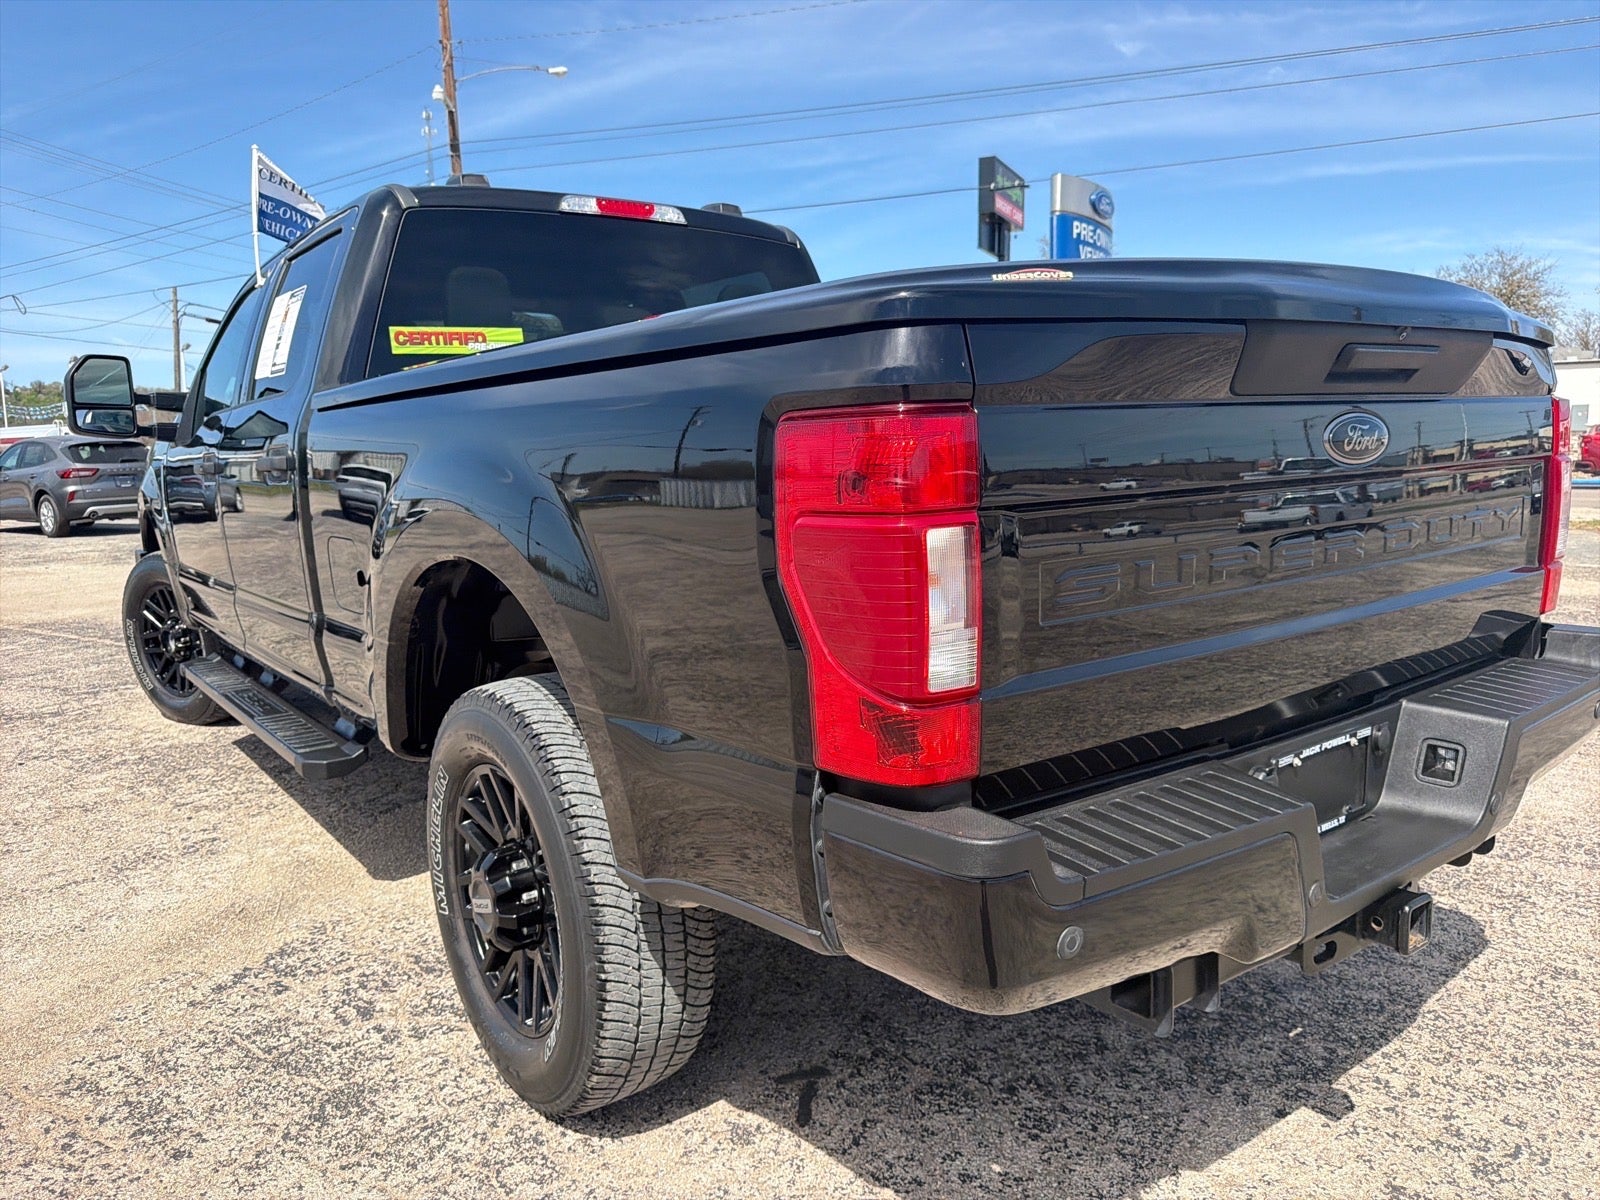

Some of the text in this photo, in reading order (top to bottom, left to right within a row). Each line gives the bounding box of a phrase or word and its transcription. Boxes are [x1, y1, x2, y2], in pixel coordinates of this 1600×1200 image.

[394, 331, 487, 346] CERTIFIED
[1344, 423, 1380, 452] Ford
[1054, 504, 1520, 610] SUPER DUTY
[1299, 744, 1321, 759] JACK
[430, 764, 450, 916] MICHELIN
